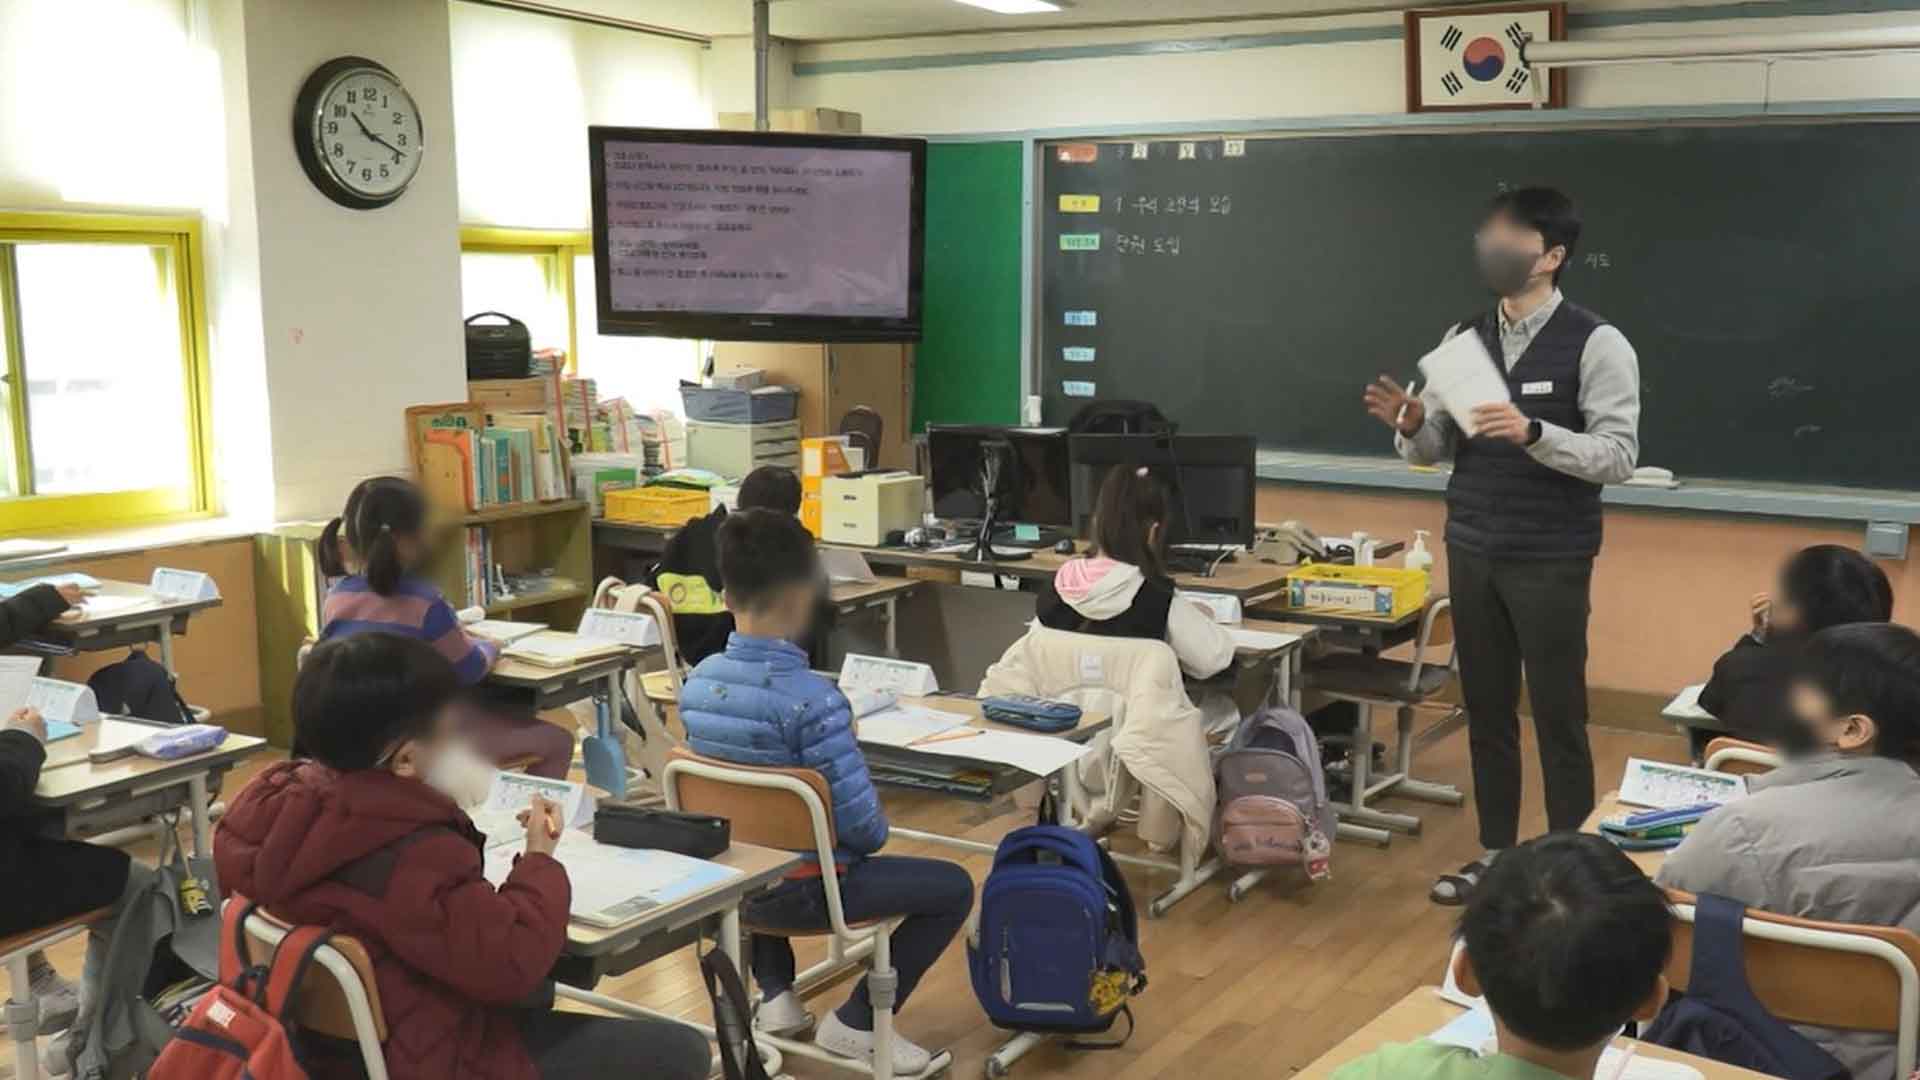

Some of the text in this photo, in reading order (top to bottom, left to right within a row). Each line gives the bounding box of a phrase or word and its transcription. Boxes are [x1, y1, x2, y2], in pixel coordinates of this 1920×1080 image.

[347, 90, 356, 104] 11
[363, 88, 377, 101] 12
[382, 95, 388, 108] 1
[334, 104, 347, 118] 10
[392, 112, 402, 125] 2
[328, 121, 338, 134] 9
[398, 133, 406, 146] 3
[334, 143, 344, 158] 8
[346, 160, 356, 174] 7
[380, 164, 389, 177] 5
[362, 168, 372, 181] 6
[1131, 195, 1158, 215] 우리
[1209, 194, 1231, 215] 모습
[1117, 233, 1145, 255] 단원
[1152, 234, 1181, 255] 도입
[1584, 253, 1610, 269] 지도
